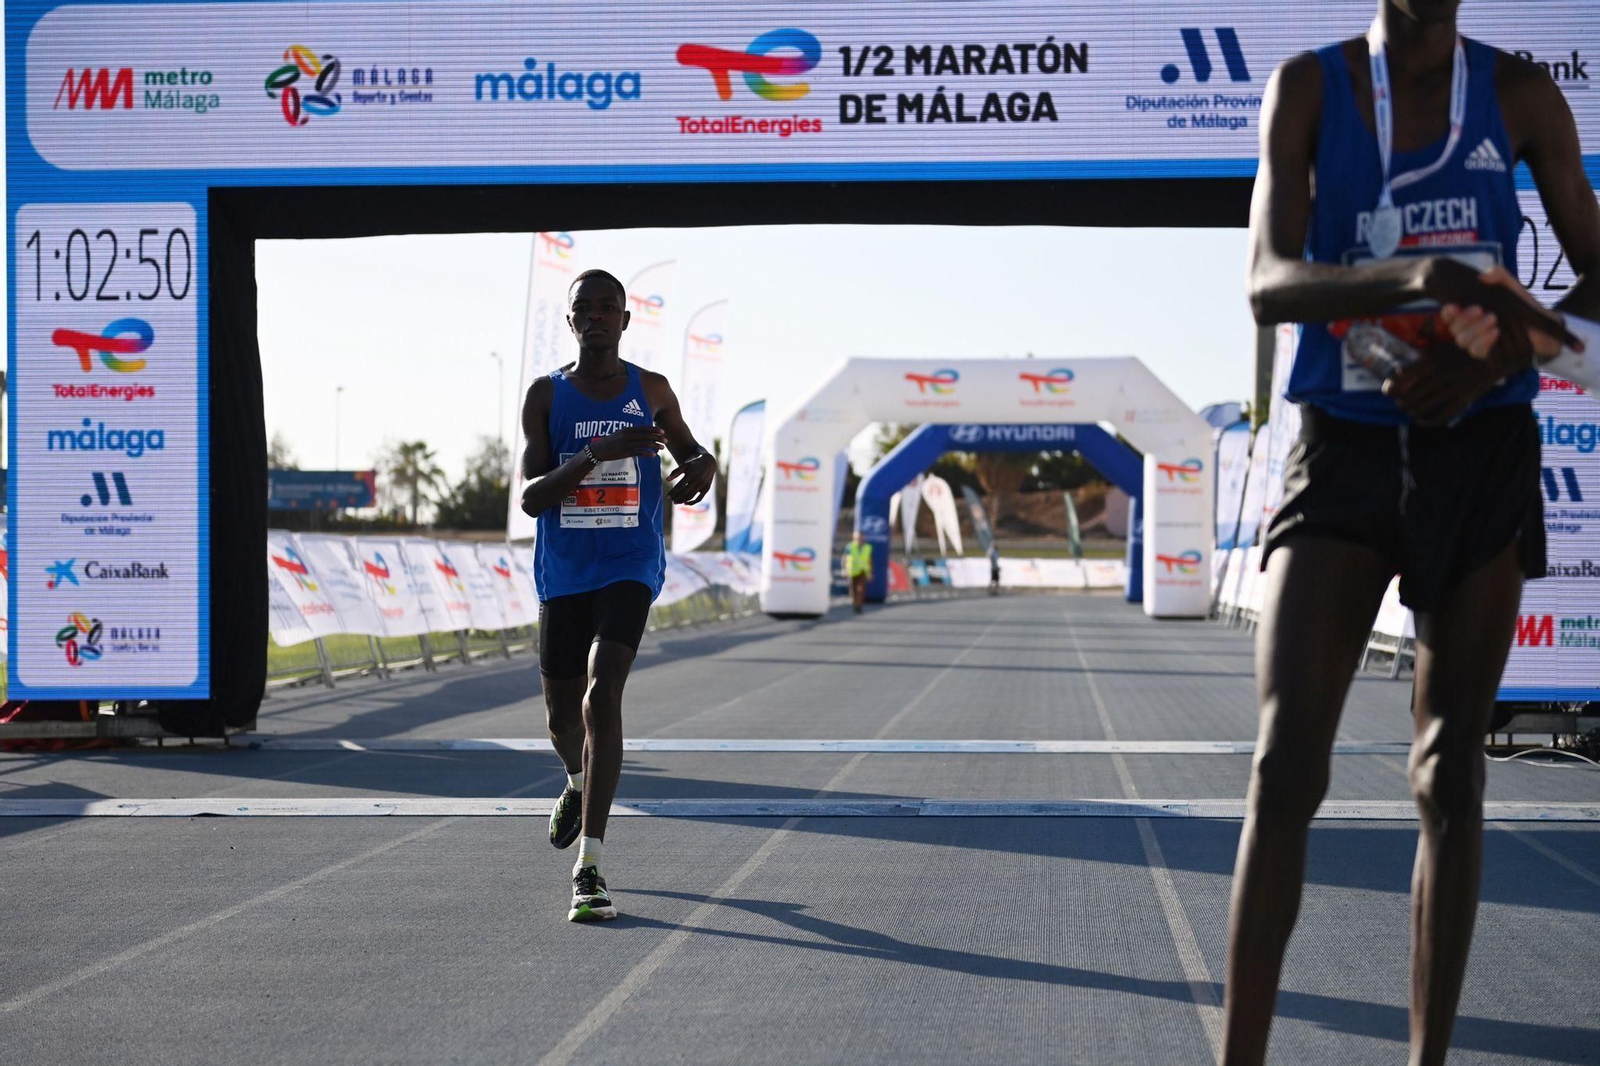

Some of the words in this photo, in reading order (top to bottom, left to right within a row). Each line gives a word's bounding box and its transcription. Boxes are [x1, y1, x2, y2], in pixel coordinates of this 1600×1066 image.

[839, 46, 894, 76] 1/2
[905, 36, 1089, 75] MARATÓN
[144, 68, 213, 86] metro
[353, 64, 433, 85] MÁLAGA
[475, 57, 641, 110] málaga
[144, 90, 220, 114] Málaga
[839, 94, 887, 124] DE
[898, 86, 1058, 124] MÁLAGA
[1126, 94, 1209, 112] Diputación
[1214, 94, 1262, 108] Provin
[676, 116, 822, 137] TotalEnergies
[1167, 115, 1187, 128] de
[1191, 113, 1248, 130] Málaga
[1464, 157, 1507, 172] adidas
[1356, 197, 1478, 243] RCZECH
[26, 228, 191, 300] 1:02:50
[52, 384, 155, 401] TotalEnergies
[622, 407, 644, 418] adidas
[48, 418, 164, 458] málaga
[574, 420, 633, 439] RUNCZE
[987, 425, 1076, 442] HYUNDAI
[596, 489, 606, 504] 2
[84, 561, 168, 579] CaixaBank
[1561, 615, 1600, 629] metr
